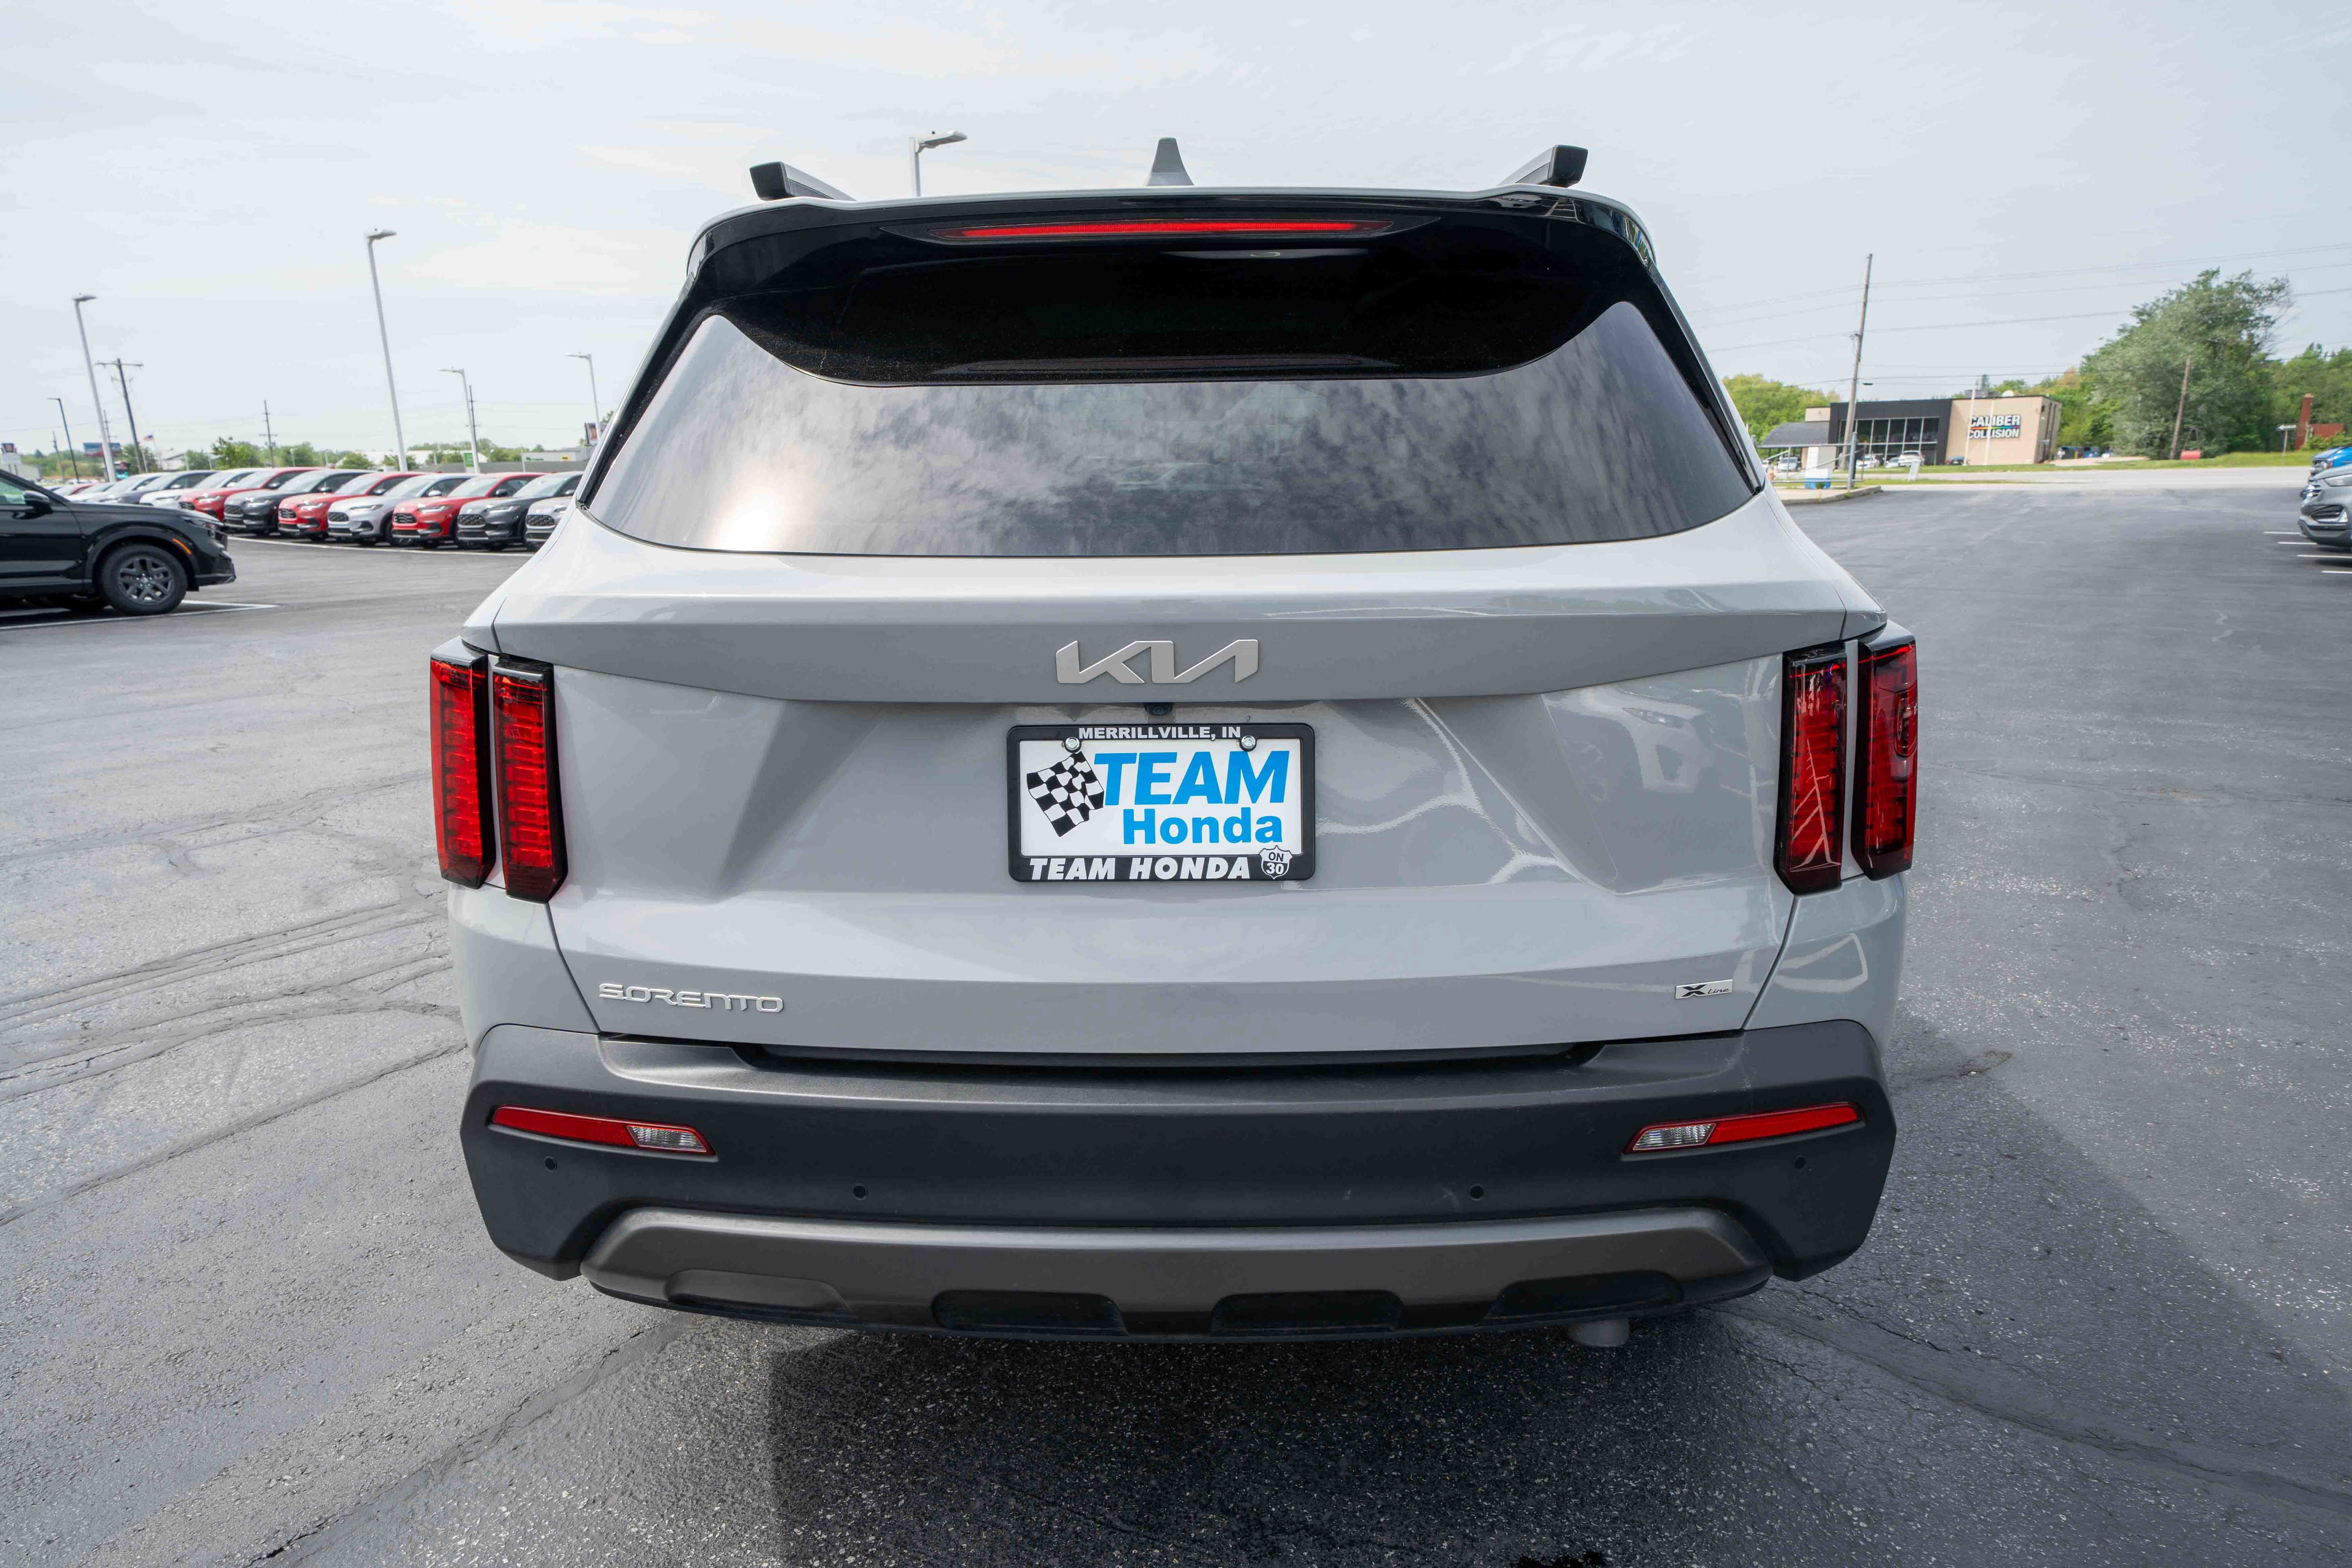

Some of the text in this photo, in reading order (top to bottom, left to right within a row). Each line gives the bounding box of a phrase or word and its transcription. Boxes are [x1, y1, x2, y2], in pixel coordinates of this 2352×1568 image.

[1971, 414, 2020, 427] CALIBER
[1056, 639, 1258, 684] KIA
[1078, 726, 1241, 741] MERRILLVILLE, IN
[1094, 751, 1290, 806] TEAM
[1123, 807, 1283, 844] Honda
[1030, 857, 1250, 880] TEAM HONDA
[1266, 862, 1285, 875] 30
[1268, 852, 1285, 862] ON
[599, 983, 784, 1013] SORENTO
